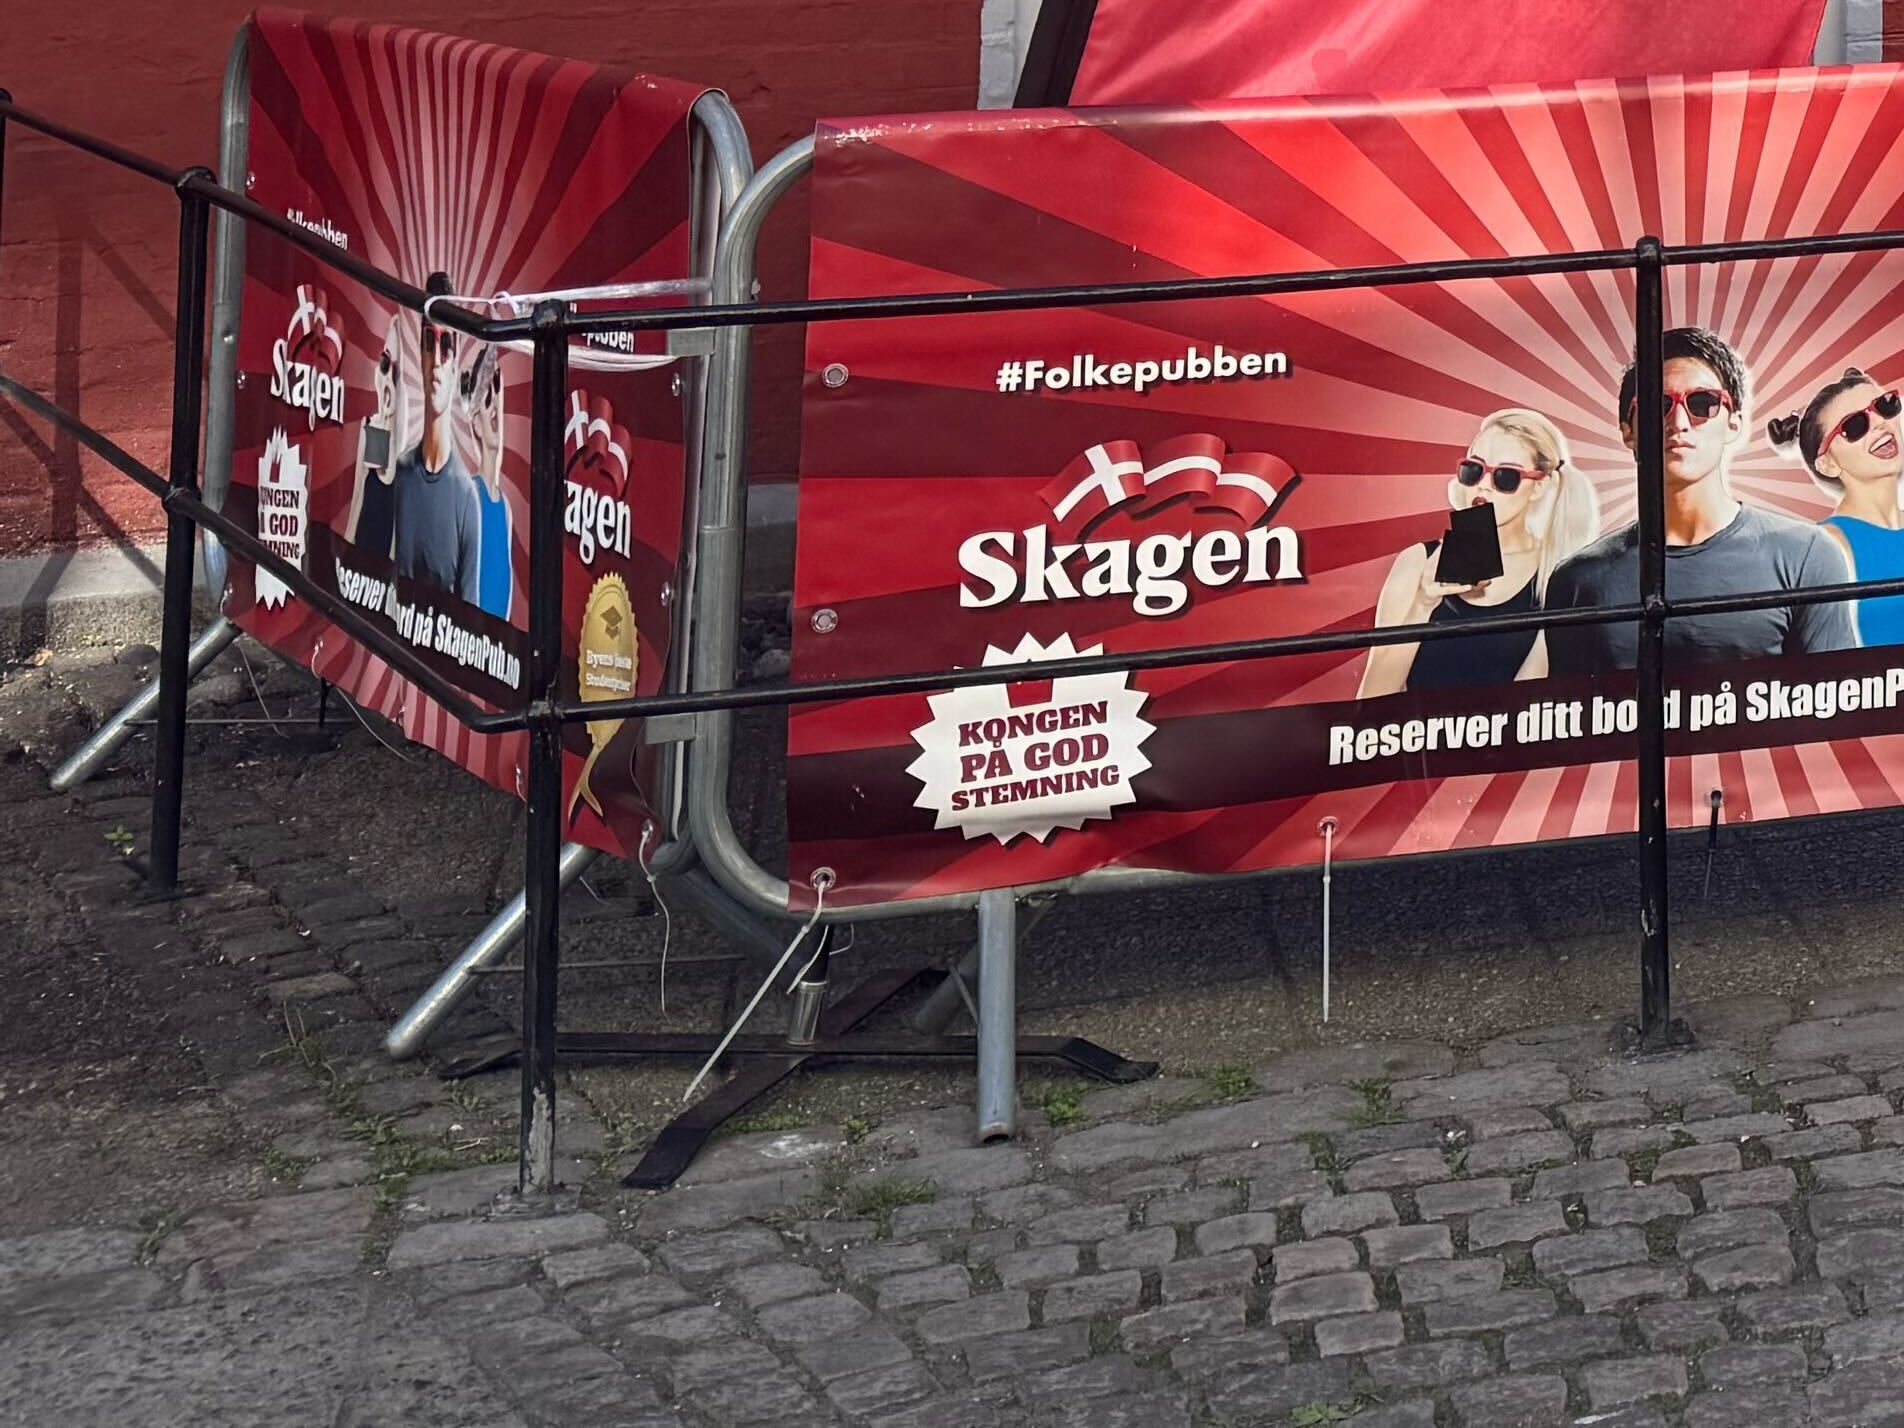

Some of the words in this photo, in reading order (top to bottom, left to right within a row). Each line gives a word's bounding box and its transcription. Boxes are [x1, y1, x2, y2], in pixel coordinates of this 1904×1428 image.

[996, 345, 1287, 392] #Folkepubben
[270, 513, 298, 536] GOD
[565, 480, 631, 565] agen
[958, 524, 1302, 616] Skagen
[435, 613, 520, 690] SkagenPub.no
[958, 701, 1109, 747] KONGEN
[1328, 710, 1508, 764] Reserver
[1517, 701, 1583, 744] ditt
[1592, 688, 1681, 735] bod
[1690, 682, 1738, 731] på
[960, 740, 1013, 784] PÅ
[1023, 732, 1109, 772] GOD
[951, 764, 1120, 811] STEMNING
